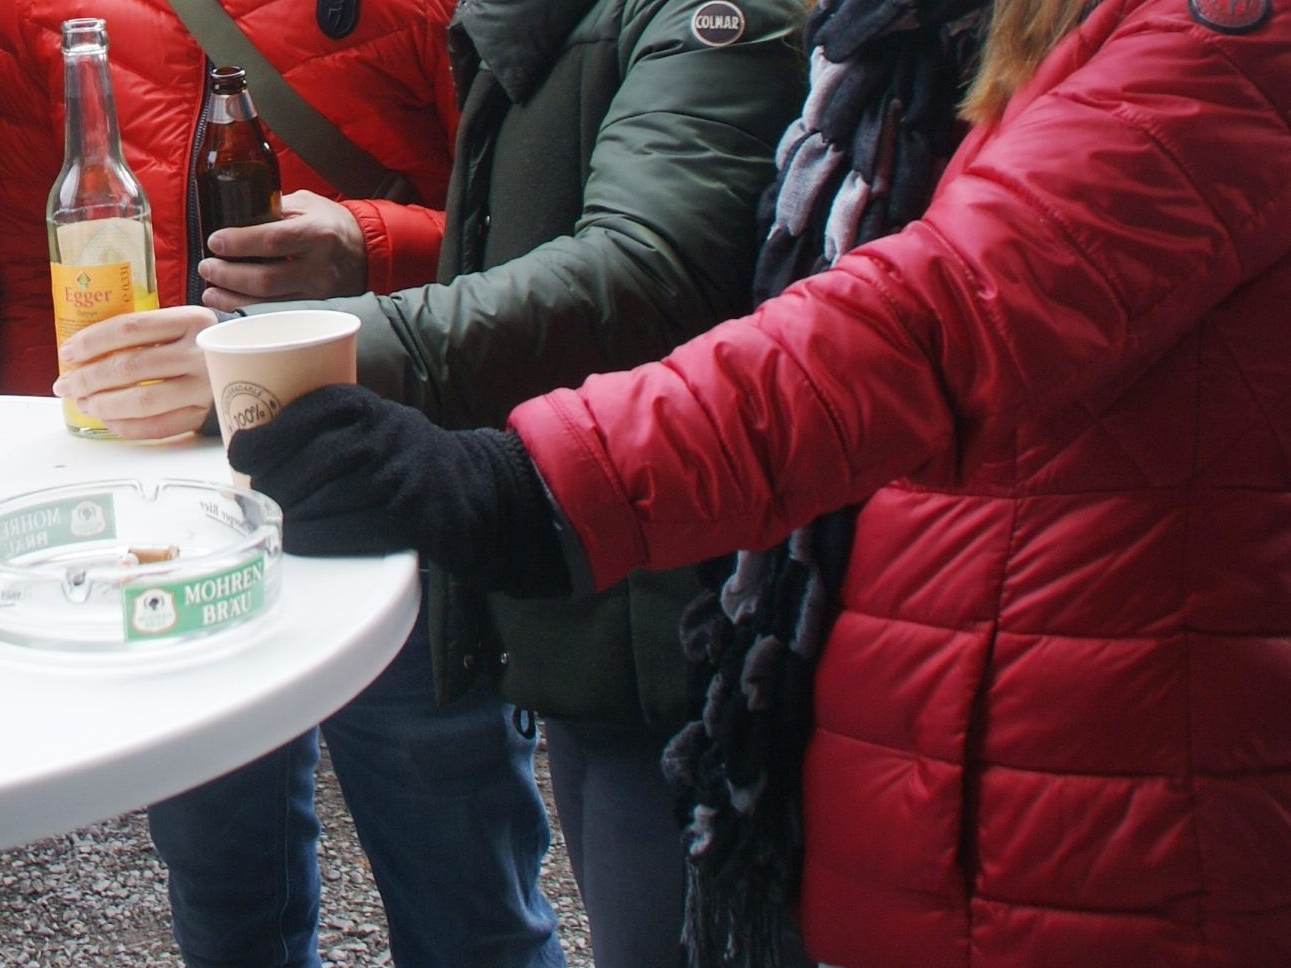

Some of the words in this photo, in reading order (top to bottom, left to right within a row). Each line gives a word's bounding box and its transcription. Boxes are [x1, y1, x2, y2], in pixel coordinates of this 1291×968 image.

[695, 15, 740, 30] COLMAR
[64, 286, 113, 308] Egger
[233, 403, 265, 430] 100%
[183, 561, 263, 606] MOHREN
